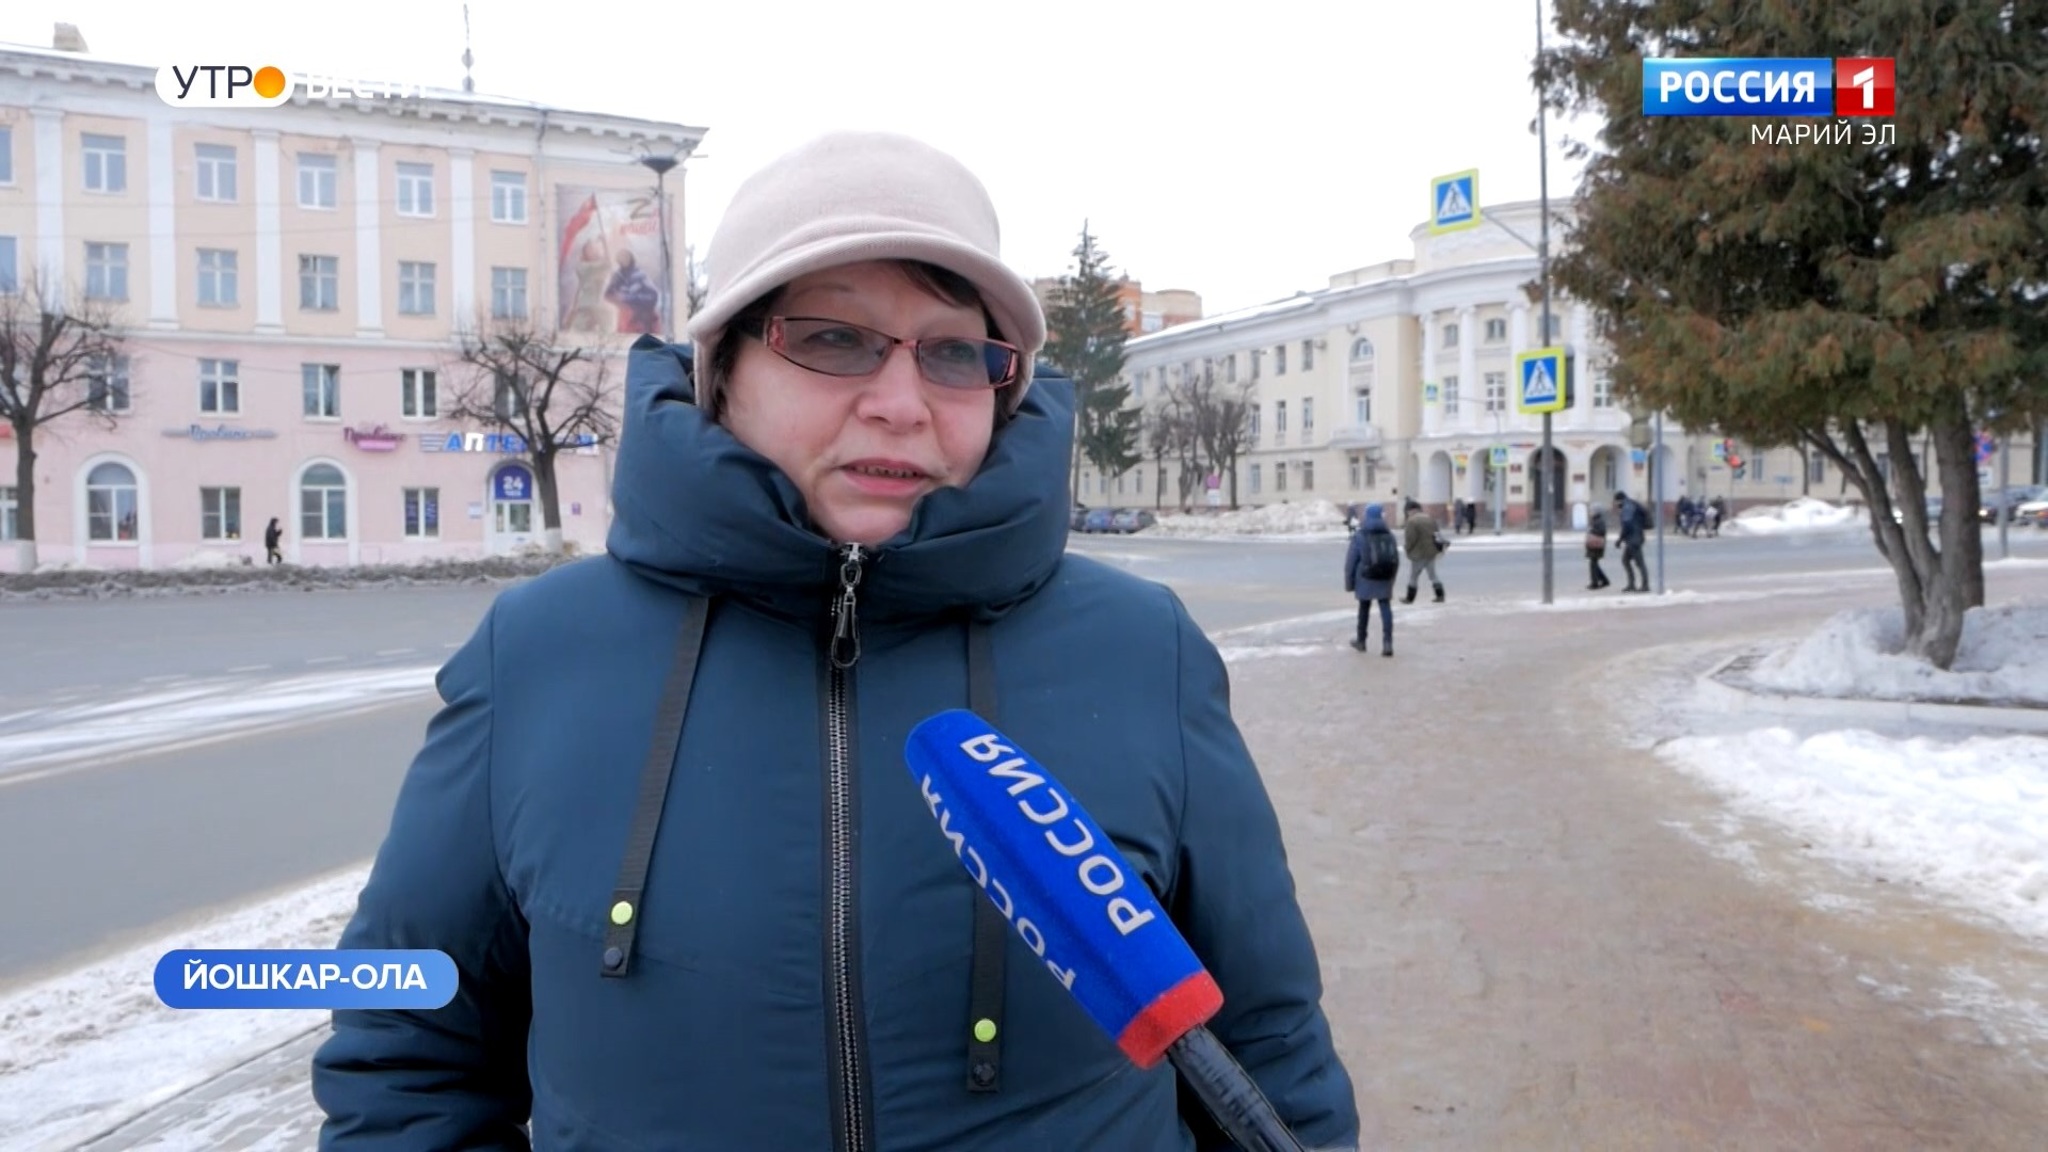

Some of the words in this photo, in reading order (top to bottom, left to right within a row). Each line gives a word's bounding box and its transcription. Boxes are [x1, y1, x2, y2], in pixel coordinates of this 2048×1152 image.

[503, 476, 523, 490] 24
[921, 774, 1077, 991] РОССИЯ
[960, 733, 1155, 936] РОССИЯ
